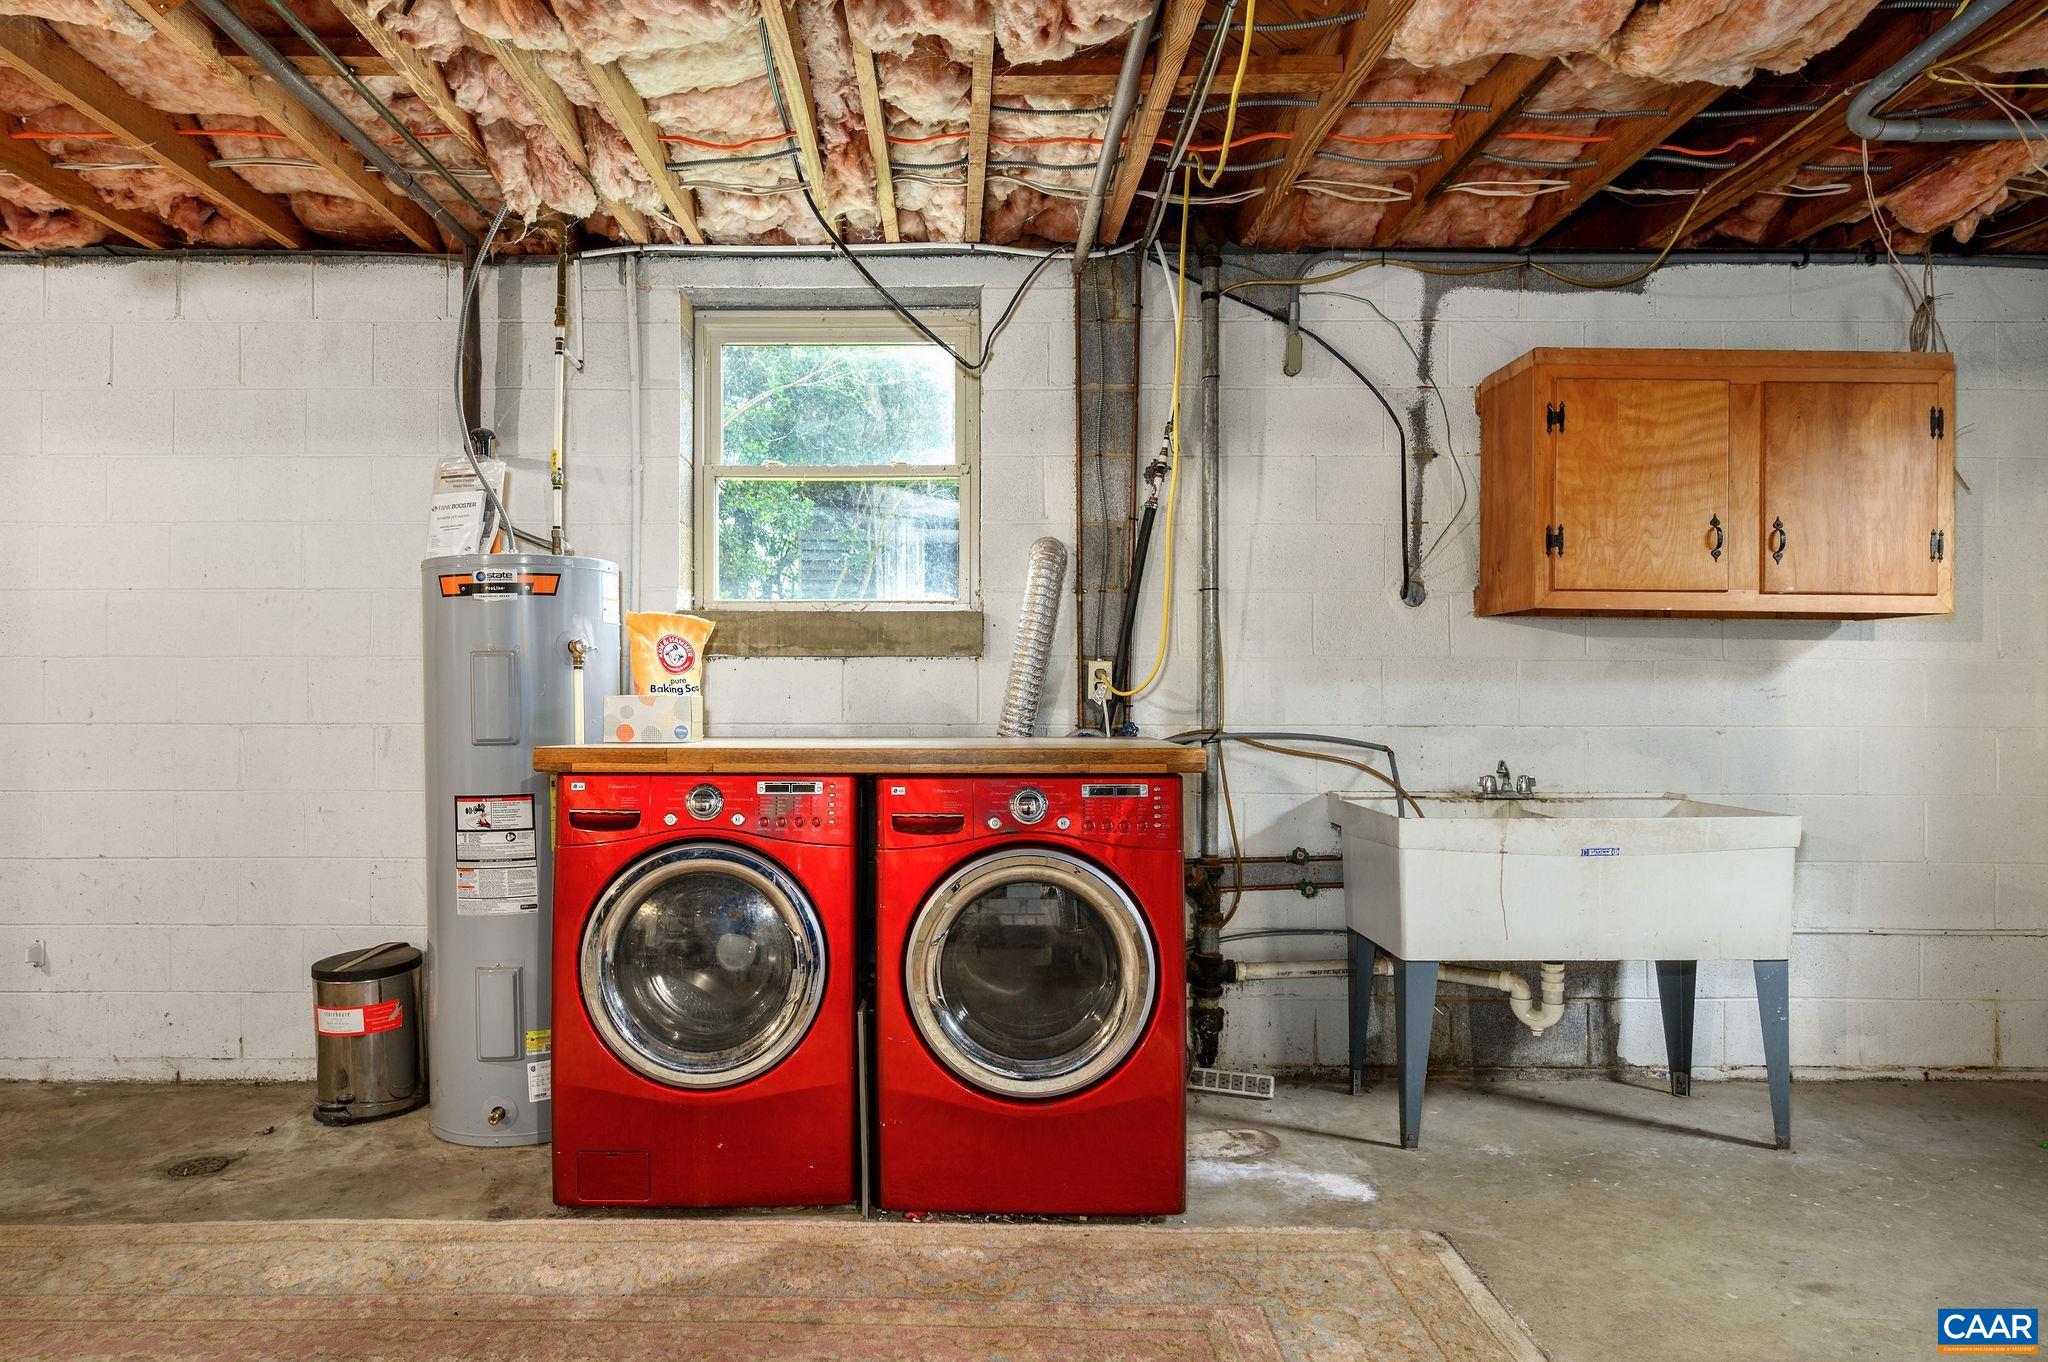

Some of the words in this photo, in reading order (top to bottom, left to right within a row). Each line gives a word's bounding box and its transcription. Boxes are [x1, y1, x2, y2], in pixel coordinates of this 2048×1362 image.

[451, 502, 477, 510] BOOSTER
[486, 571, 513, 579] state
[669, 637, 692, 657] HAMMER
[670, 678, 687, 686] pure
[650, 684, 684, 696] Baking
